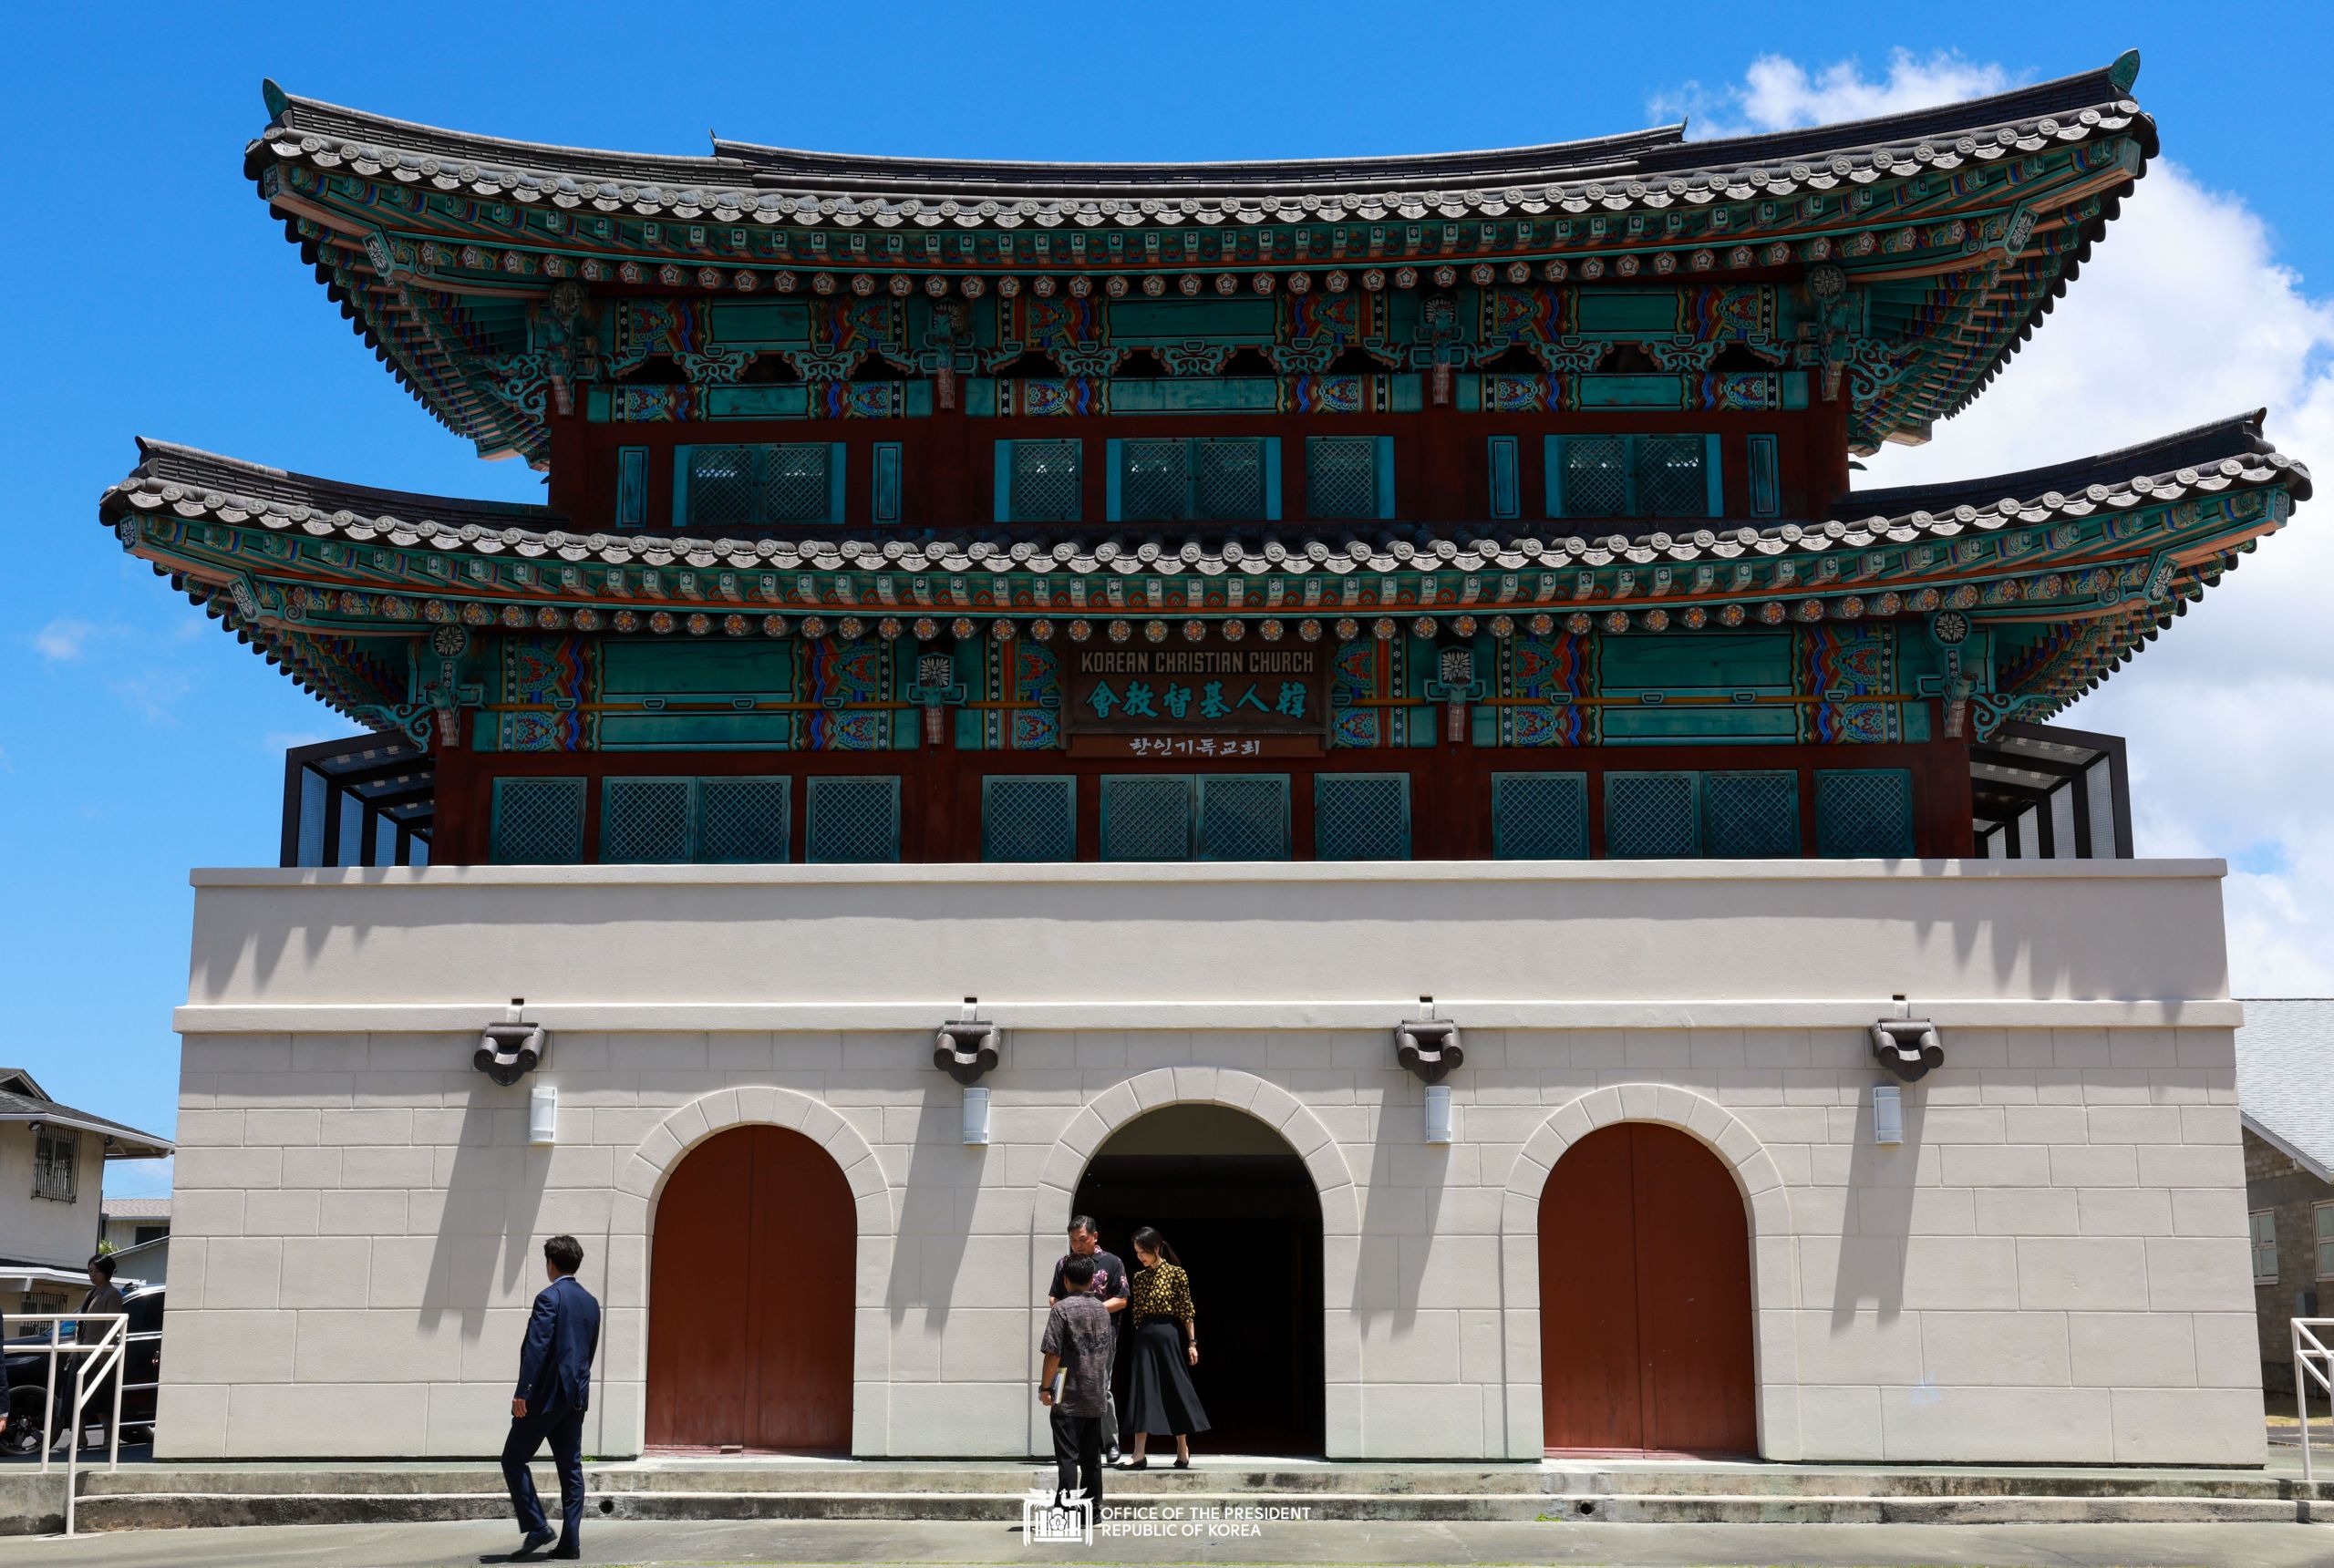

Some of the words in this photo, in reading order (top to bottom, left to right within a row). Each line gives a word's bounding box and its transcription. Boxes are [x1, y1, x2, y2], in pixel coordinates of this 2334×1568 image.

[1081, 652, 1149, 673] KOREAN
[1155, 652, 1244, 673] CHRISTIAN
[1249, 652, 1314, 673] CHURCH
[1129, 738, 1261, 756] 한인기독교회
